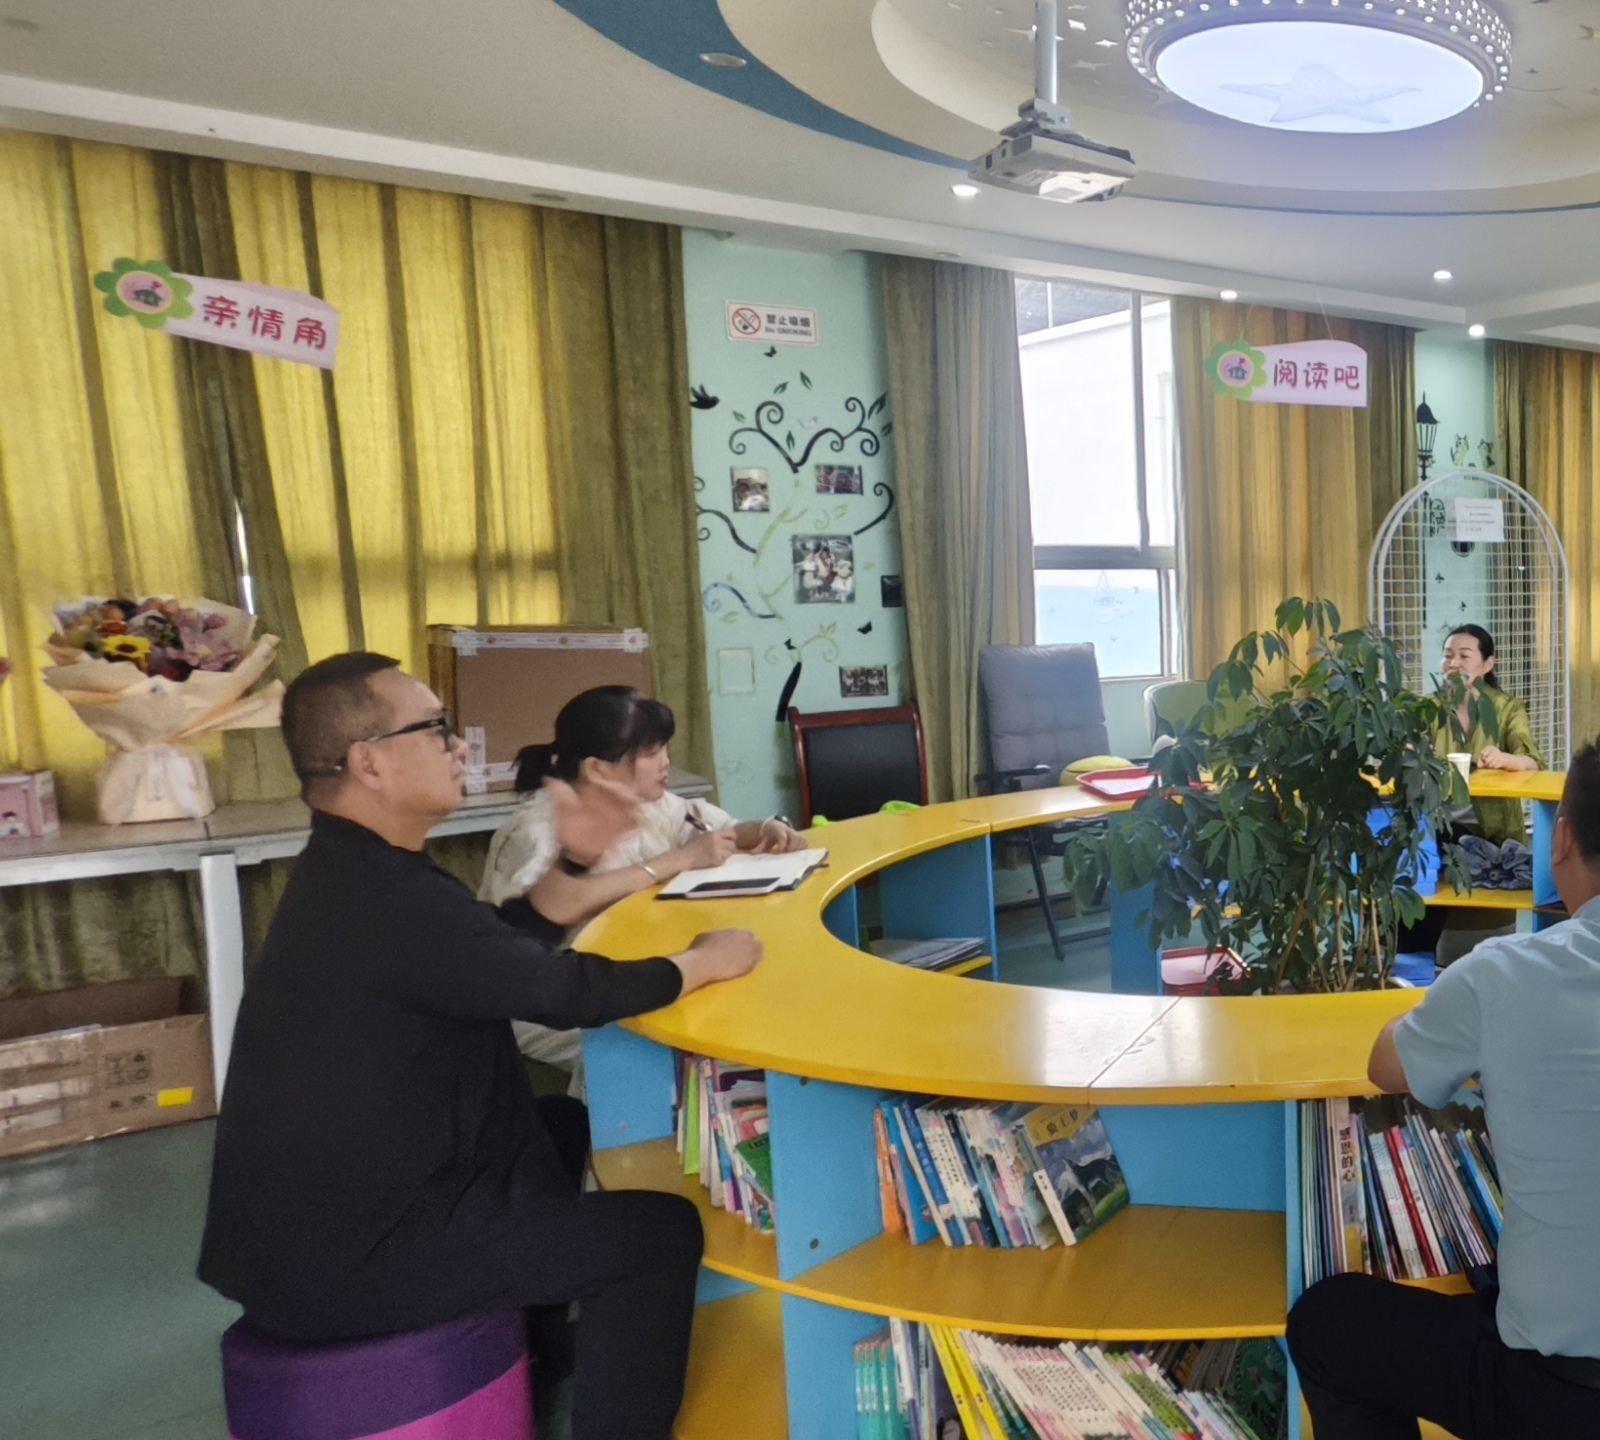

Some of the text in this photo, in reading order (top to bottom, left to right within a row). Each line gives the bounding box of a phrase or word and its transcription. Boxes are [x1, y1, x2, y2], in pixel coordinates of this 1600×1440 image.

[201, 293, 329, 350] 亲情角
[766, 313, 811, 328] 禁止吸烟
[1272, 357, 1361, 393] 阅读吧
[1339, 1126, 1356, 1182] 感恩的心
